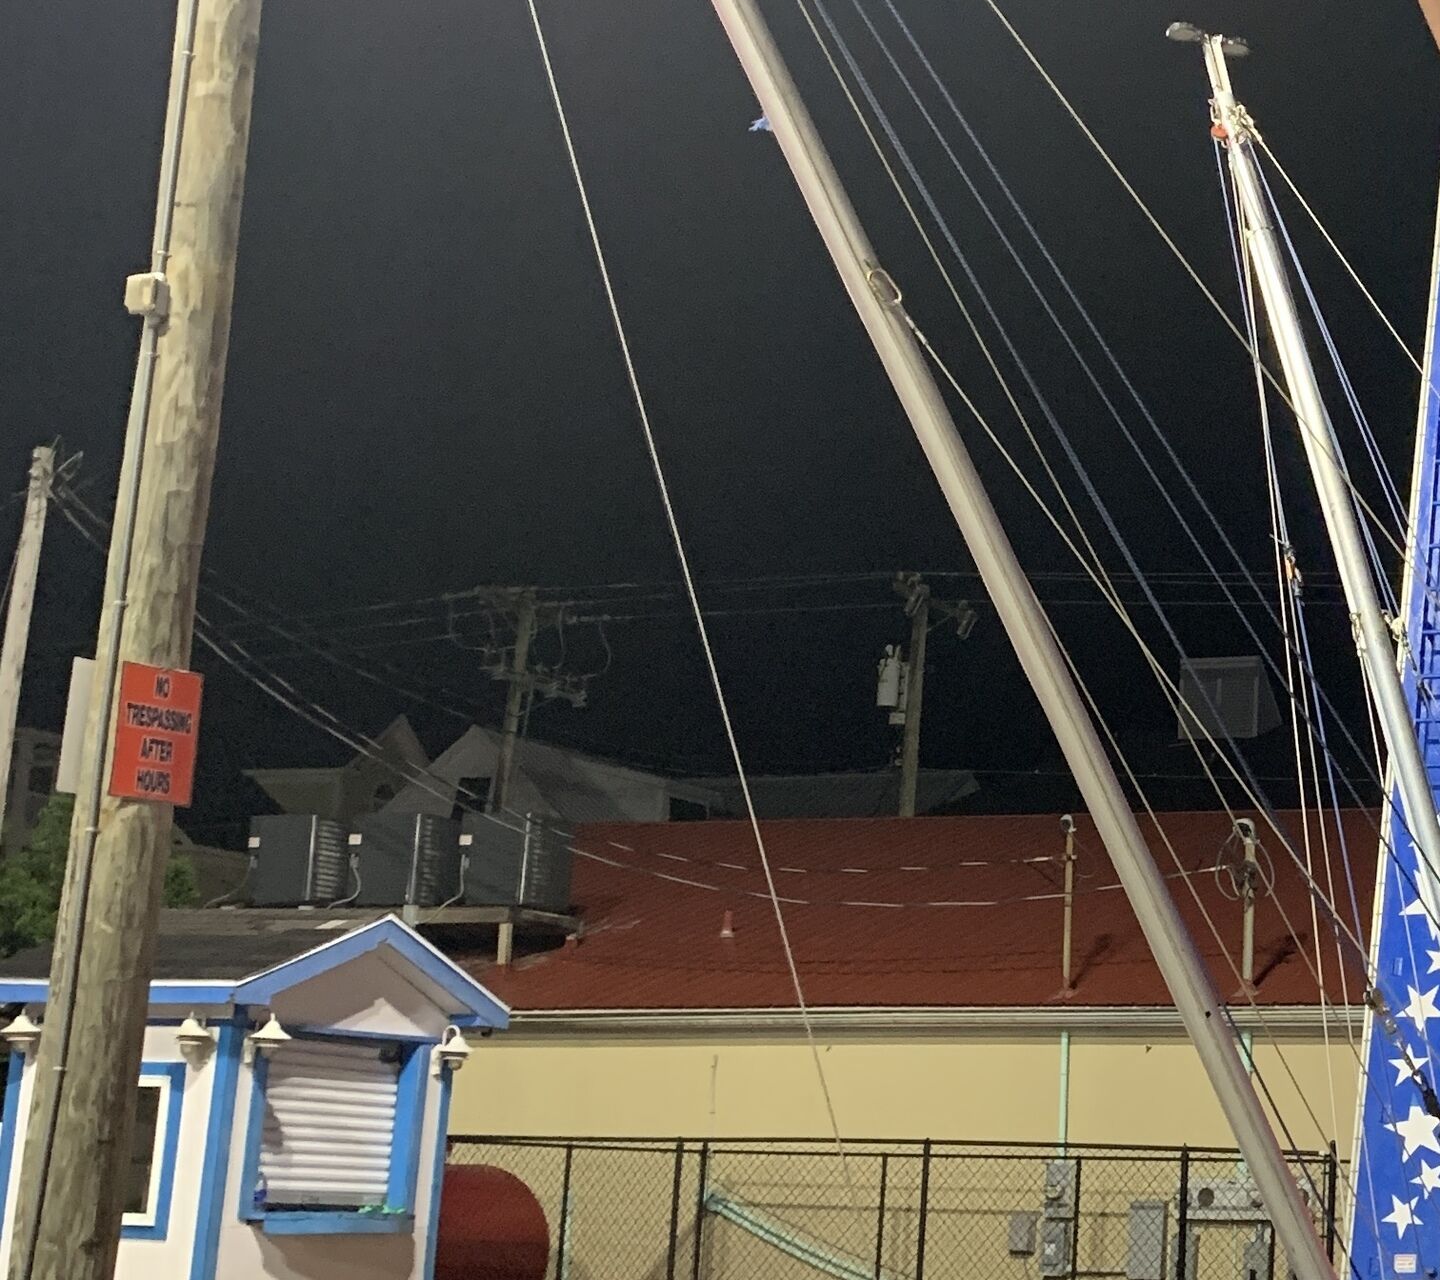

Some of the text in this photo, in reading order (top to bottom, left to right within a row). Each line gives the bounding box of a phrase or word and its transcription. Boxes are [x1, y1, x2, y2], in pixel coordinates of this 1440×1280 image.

[156, 676, 171, 698] NO
[127, 702, 192, 734] TRESPASSING
[141, 738, 173, 762] AFTER
[137, 769, 171, 794] HOURS
